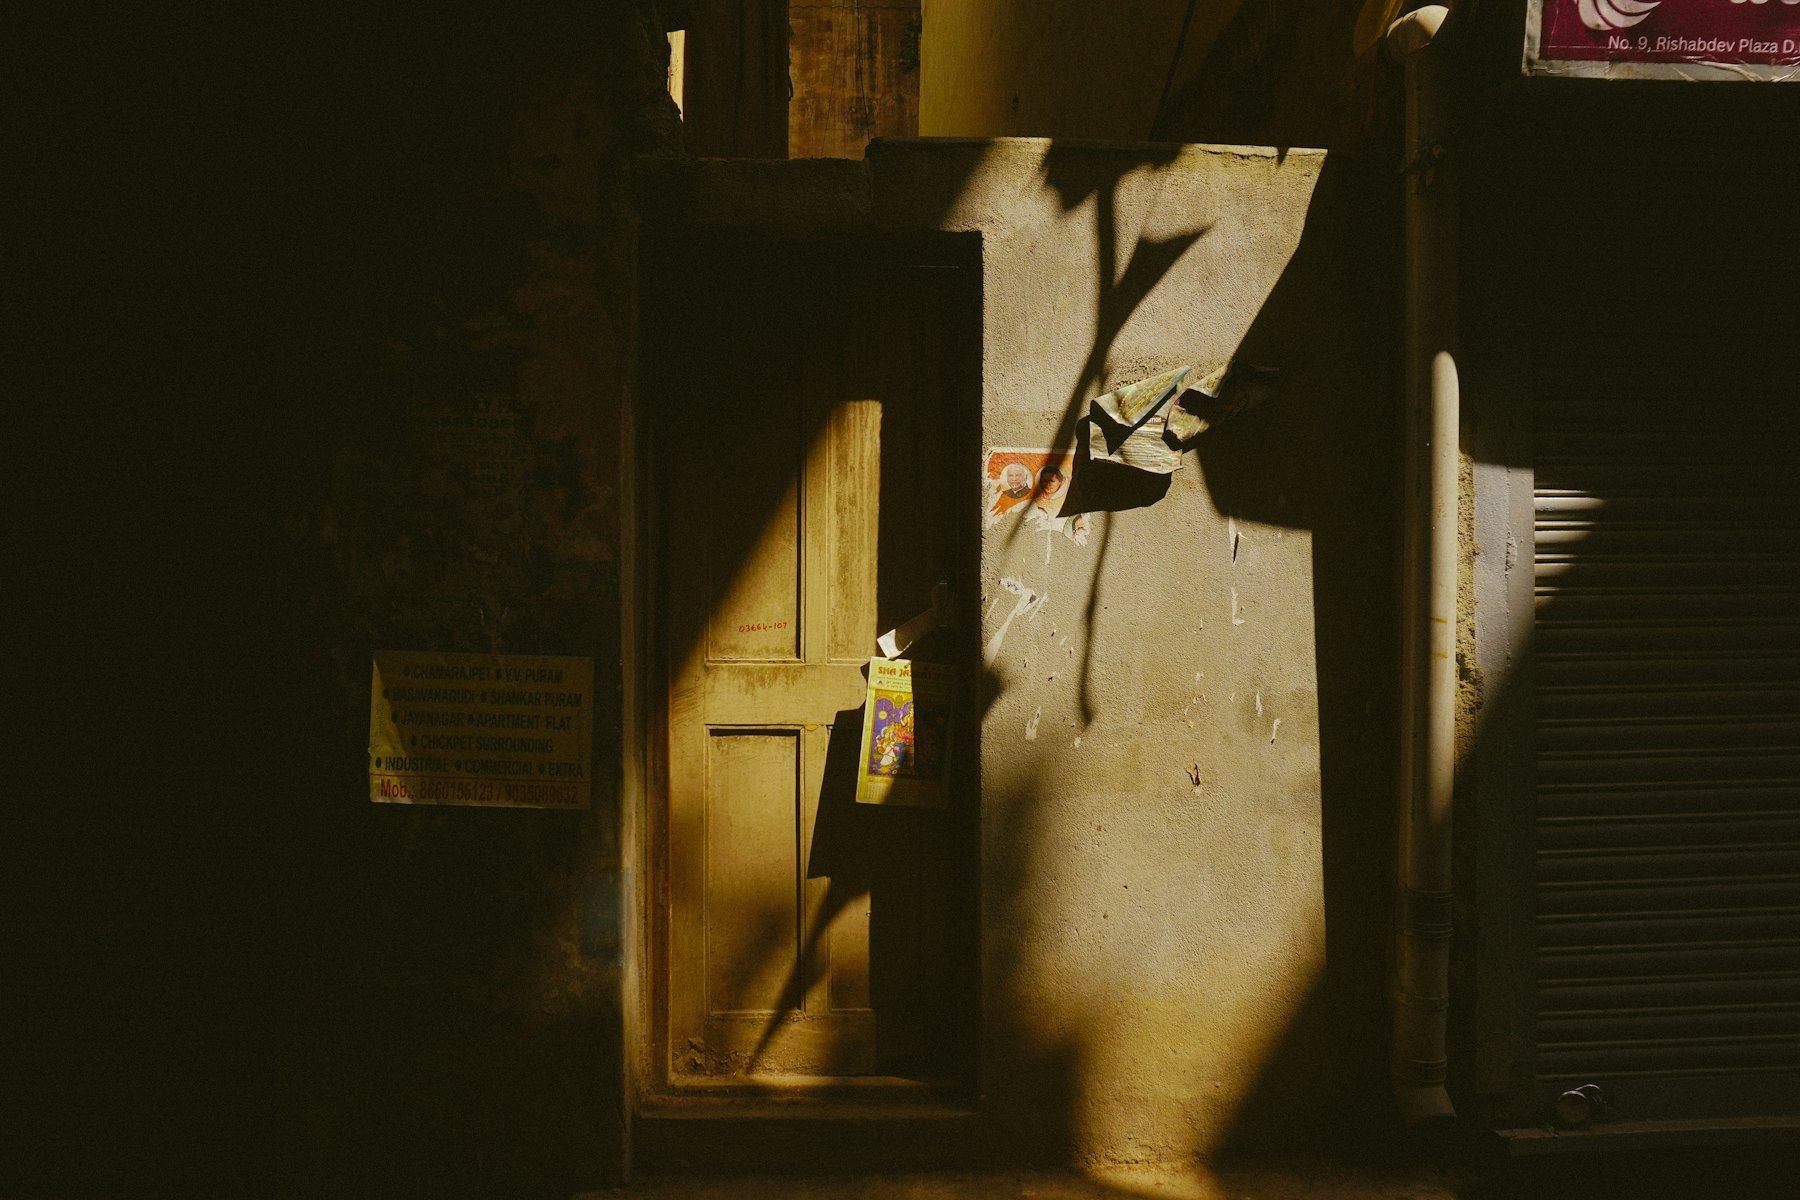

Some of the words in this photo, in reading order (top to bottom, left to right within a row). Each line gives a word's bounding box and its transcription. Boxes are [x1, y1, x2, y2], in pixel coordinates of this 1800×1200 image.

[1608, 36, 1633, 51] No.
[1638, 36, 1652, 54] 9,
[1656, 36, 1735, 53] Rishabdev
[1738, 38, 1778, 53] Plaza
[525, 669, 564, 684] PURAM
[477, 713, 540, 728] APARTMENT
[546, 716, 572, 730] FLAT
[421, 736, 475, 751] CHICKPET
[476, 737, 553, 754] SURROUNDING
[385, 758, 449, 772] INDUSTRIAL
[465, 760, 534, 776] COMMERCIAL
[548, 763, 584, 778] EXTRA
